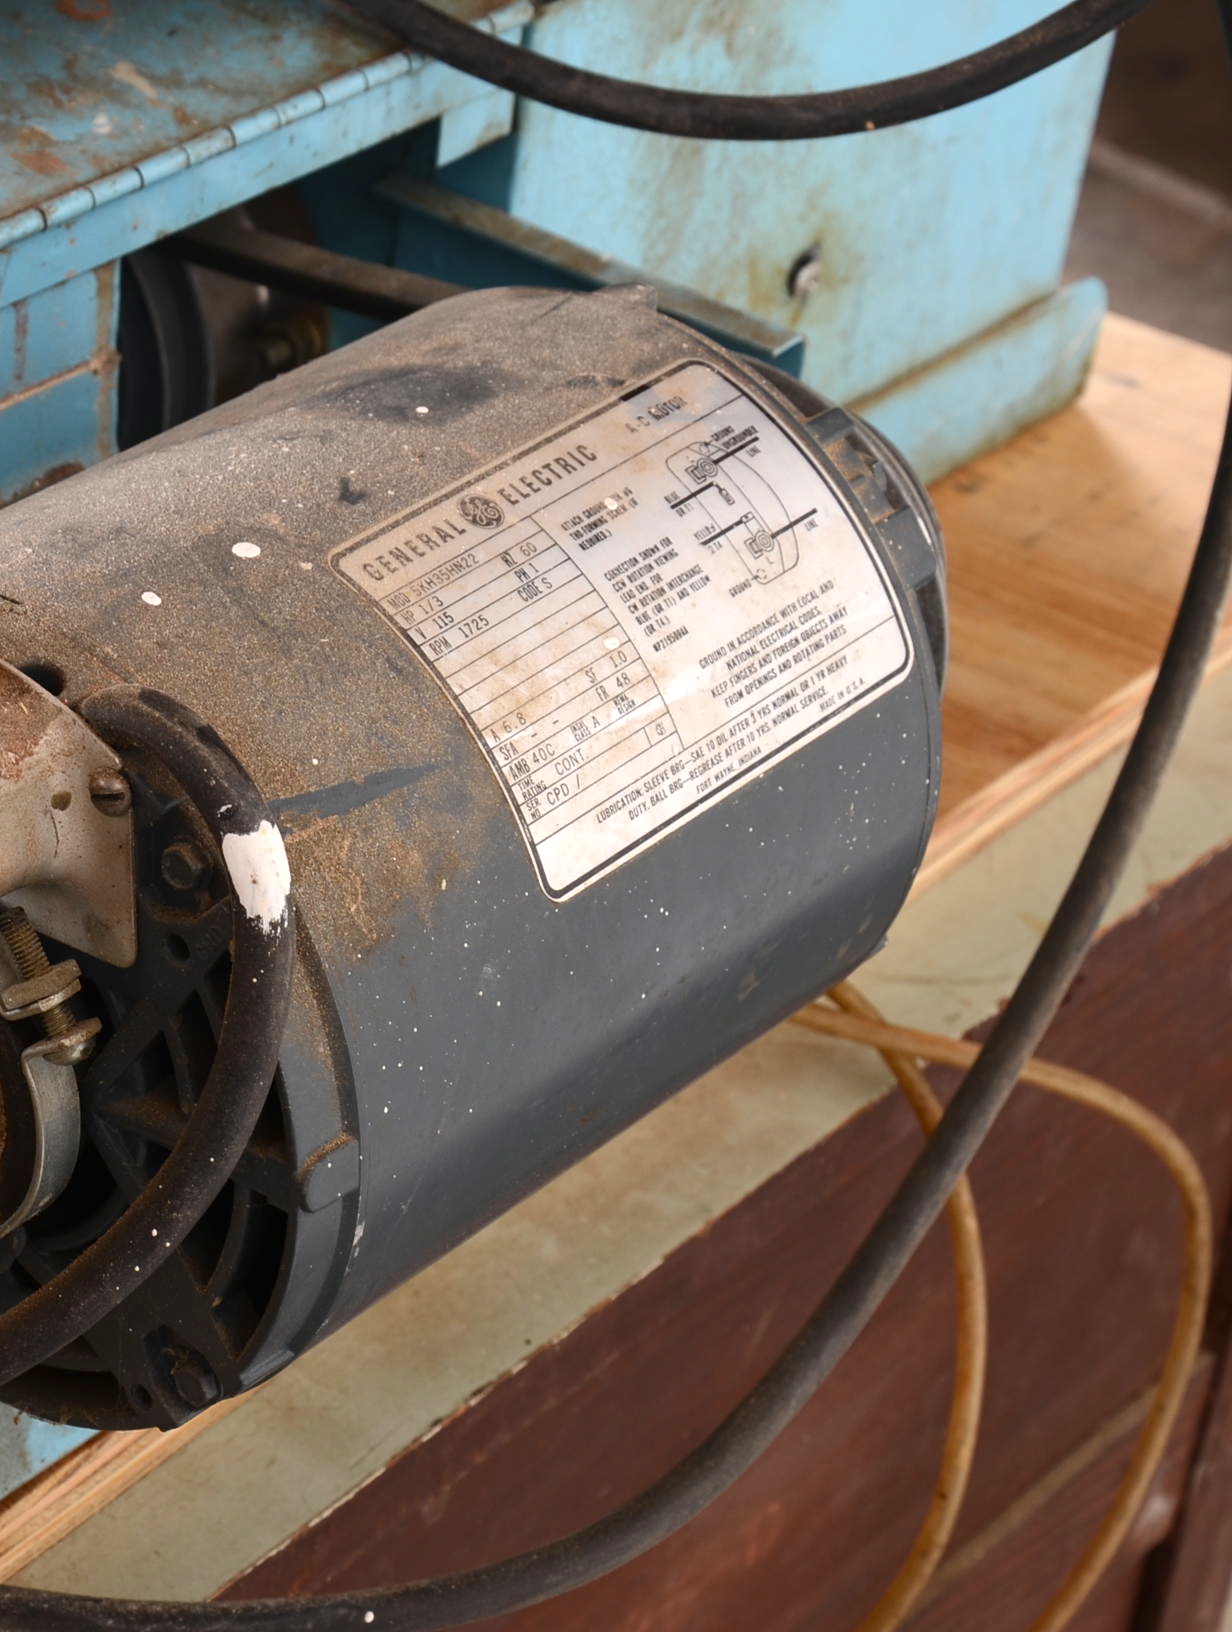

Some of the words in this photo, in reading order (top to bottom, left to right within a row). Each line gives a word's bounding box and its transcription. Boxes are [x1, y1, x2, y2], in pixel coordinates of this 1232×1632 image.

[647, 393, 688, 420] MOTOR
[361, 516, 468, 581] GENERAL
[496, 443, 598, 506] ELECTRIC
[560, 514, 584, 531] ATTACH
[499, 551, 518, 568] HZ
[518, 541, 538, 557] 60
[602, 555, 640, 581] CONNECTION
[638, 543, 661, 561] SHOWN
[658, 536, 673, 549] FOR
[611, 578, 627, 592] CCW
[625, 561, 655, 583] ROTATION
[653, 547, 679, 567] VIEWING
[386, 591, 411, 610] MOD
[409, 552, 480, 596] 5KH35HN22
[513, 567, 531, 582] PH
[528, 561, 539, 572] 1
[516, 581, 543, 603] CODE
[541, 576, 553, 589] S
[619, 588, 636, 603] LEAD
[649, 572, 663, 585] FOR
[626, 602, 639, 614] CW
[638, 585, 667, 607] ROTATION
[665, 563, 704, 591] INTERCHANGE
[634, 610, 651, 625] BLUE
[650, 602, 665, 616] (OR
[662, 594, 677, 609] T1)
[675, 586, 690, 600] AND
[688, 574, 712, 593] YELLOW
[400, 610, 417, 625] HP
[417, 594, 444, 614] 1/3
[698, 645, 727, 669] GROUND
[726, 639, 736, 652] IN
[735, 613, 779, 646] ACCORDANCE
[779, 601, 798, 618] WITH
[797, 589, 818, 608] LOCAL
[818, 578, 834, 594] AND
[414, 627, 427, 640] V
[432, 611, 455, 629] 115
[428, 636, 452, 656] RPM
[458, 614, 490, 638] 1725
[642, 622, 656, 637] (OR
[710, 680, 729, 698] KEEP
[729, 662, 757, 686] FINGERS
[756, 652, 773, 669] AND
[772, 635, 800, 659] FOREIGN
[799, 617, 828, 642] OBJECTS
[827, 605, 848, 624] AWAY
[725, 644, 758, 670] NATIONAL
[759, 619, 797, 649] ELECTRICAL
[584, 667, 598, 684] SF
[608, 649, 628, 668] 1.0
[724, 688, 744, 707] FROM
[743, 667, 777, 695] OPENINGS
[777, 657, 792, 674] AND
[791, 637, 825, 664] ROTATING
[824, 623, 846, 644] PARTS
[594, 684, 609, 701] FR
[613, 671, 631, 689] 48
[819, 695, 834, 712] MADE
[837, 689, 843, 700] IN
[617, 698, 636, 715] DESIGN
[488, 727, 500, 742] A
[501, 711, 527, 734] 6.8
[574, 726, 590, 742] CLASS
[589, 714, 600, 728] A
[643, 769, 669, 793] SLEEVE
[706, 739, 714, 752] 10
[716, 732, 726, 746] OIL
[728, 717, 750, 738] AFTER
[758, 703, 771, 719] YRS
[772, 686, 798, 710] NORMAL
[799, 679, 809, 692] OR
[816, 669, 825, 681] YR
[825, 653, 849, 675] HEAVY
[499, 740, 518, 761] SFA
[508, 758, 530, 781] AMB
[531, 742, 556, 766] 40C
[650, 788, 666, 807] BALL
[724, 737, 744, 758] AFTER
[746, 730, 754, 743] 10
[772, 703, 798, 727] NORMAL
[518, 776, 534, 791] TIME
[696, 777, 712, 794] FORT
[738, 745, 761, 767] INDIANA
[522, 779, 547, 801] RATING
[546, 781, 570, 805] CPD
